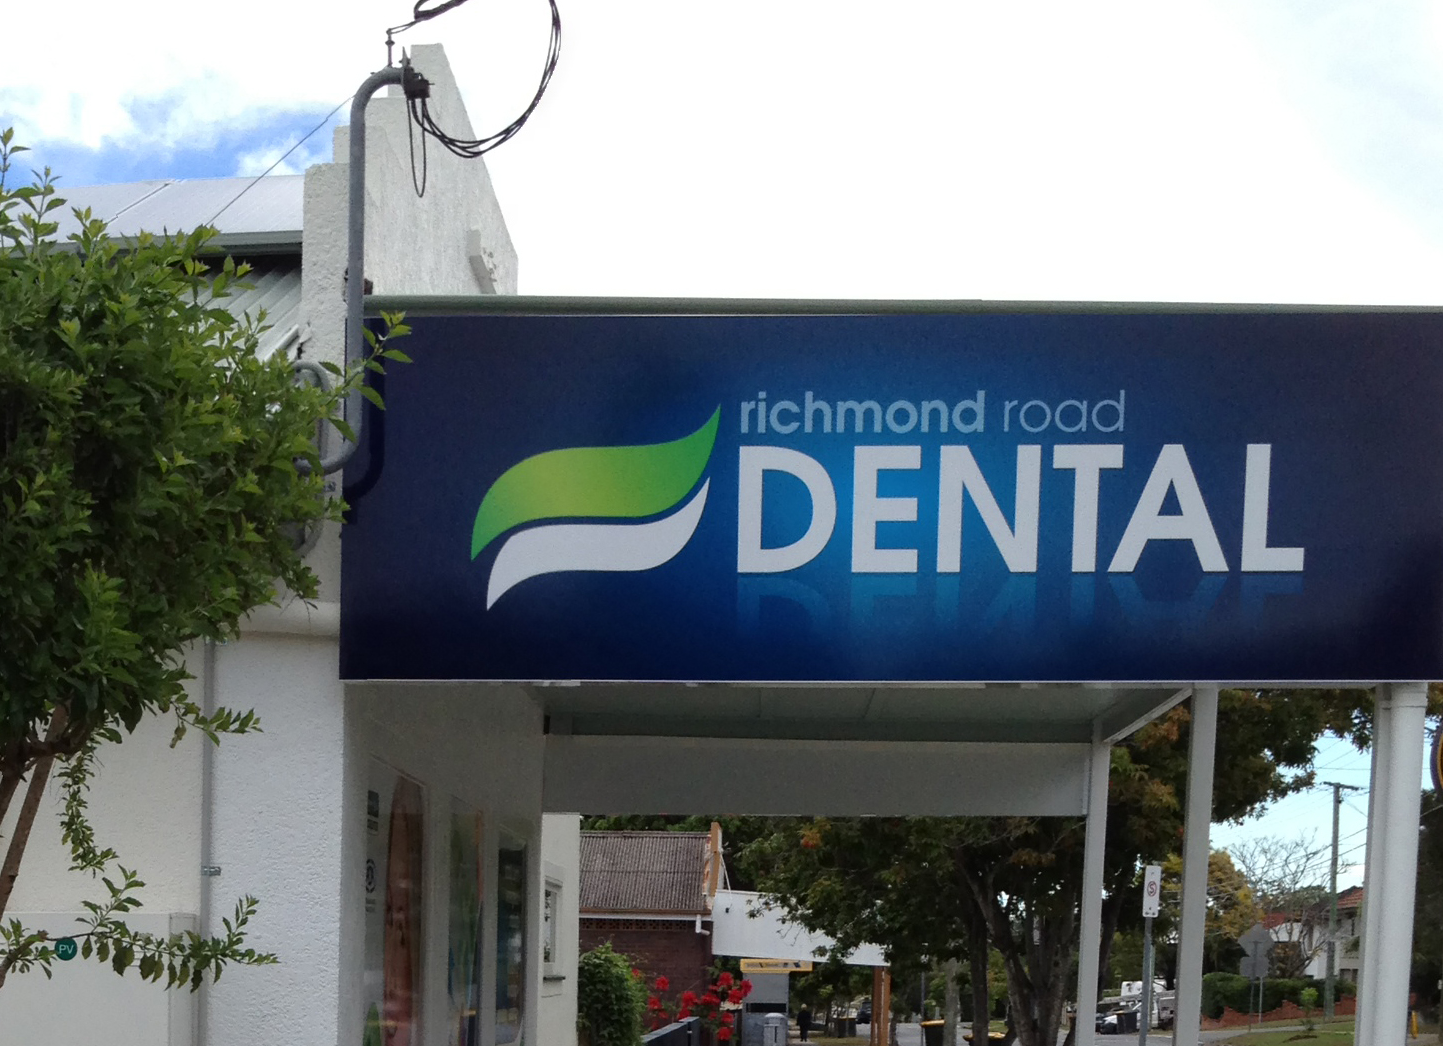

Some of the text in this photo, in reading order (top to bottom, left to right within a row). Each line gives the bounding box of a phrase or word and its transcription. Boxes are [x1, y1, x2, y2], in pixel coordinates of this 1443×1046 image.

[739, 389, 1126, 434] richmond road
[737, 443, 1305, 573] DENTAL
[58, 944, 74, 955] PV
